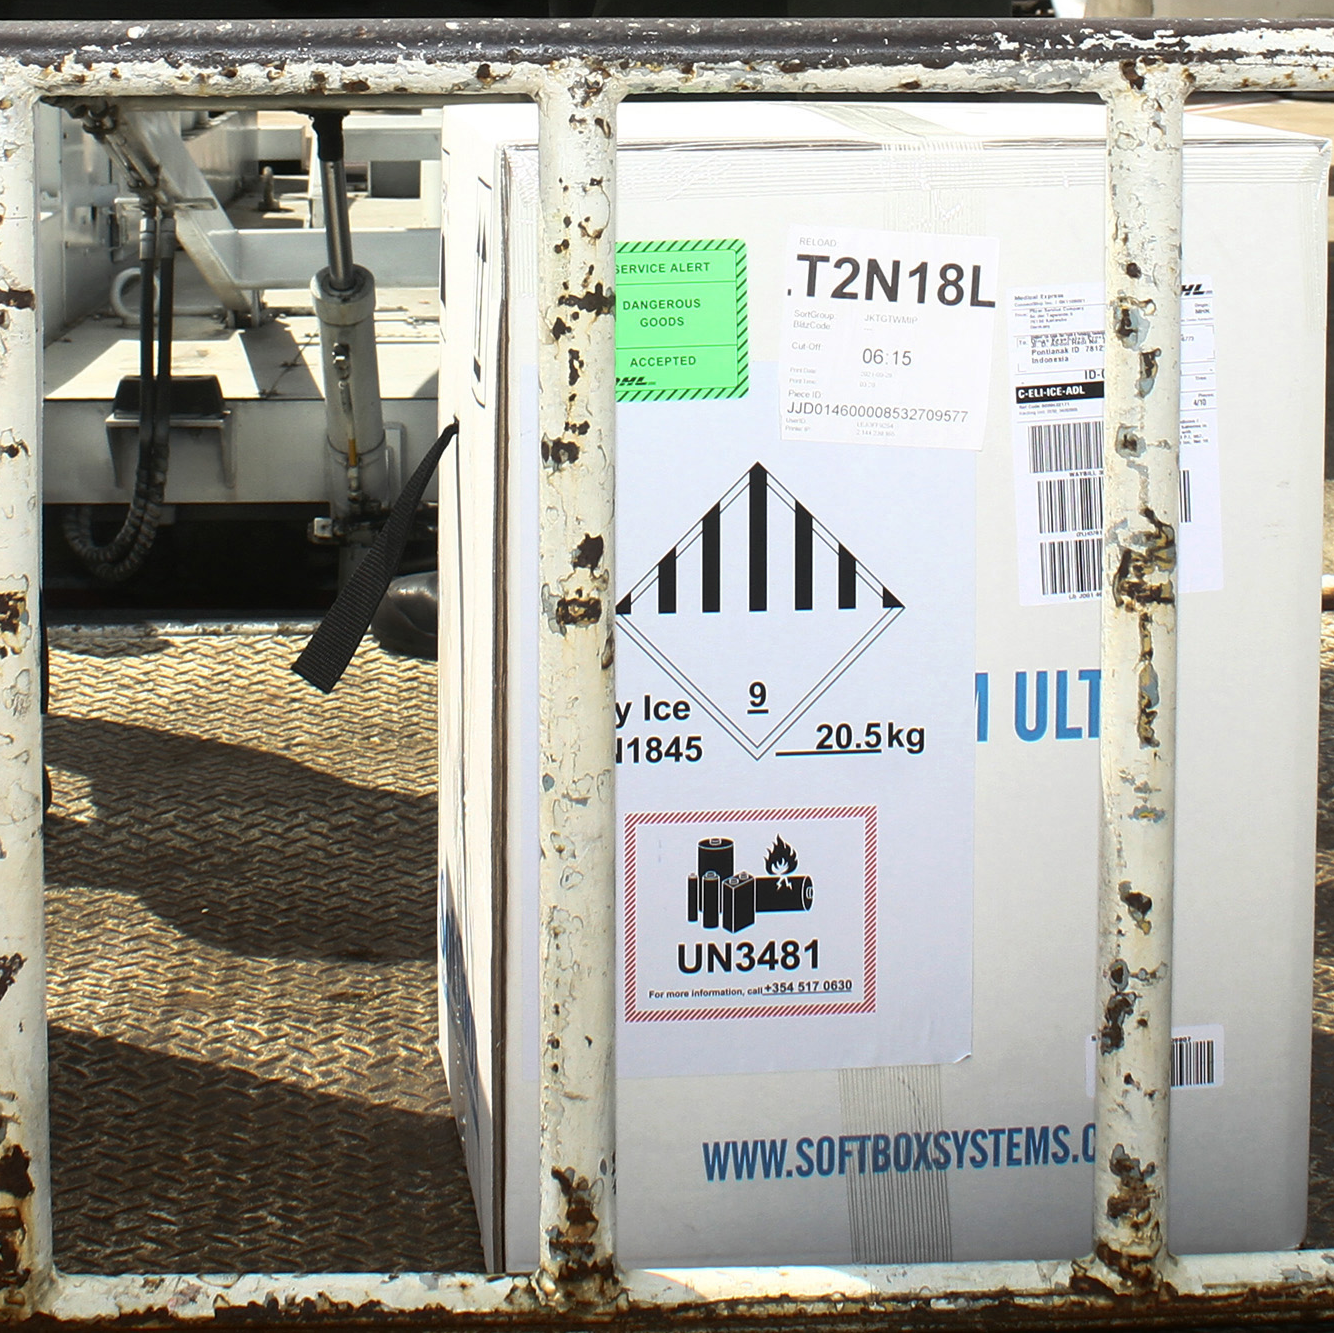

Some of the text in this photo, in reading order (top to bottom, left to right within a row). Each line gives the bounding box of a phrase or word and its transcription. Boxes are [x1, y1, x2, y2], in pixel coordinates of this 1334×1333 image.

[670, 262, 711, 273] ALERT
[622, 298, 701, 311] DANGEROUS
[639, 316, 685, 328] GOODS
[862, 348, 912, 366] 06:15
[1031, 347, 1069, 356] Pontianak
[1071, 346, 1080, 354] ID
[630, 356, 697, 367] ACCEPTED
[1031, 356, 1069, 364] Indonesia
[1017, 385, 1086, 399] C-ELI-ICE-ADL
[749, 681, 767, 707] 9
[643, 695, 691, 722] Ice
[1014, 669, 1102, 743] ULT
[677, 938, 819, 975] UN3481
[648, 990, 664, 999] For
[666, 989, 689, 999] more
[747, 986, 763, 996] call
[764, 982, 794, 993] +354
[797, 980, 820, 993] 517
[823, 979, 853, 991] 0630
[702, 1122, 1096, 1182] WWW.SOFTBOXSYSTEMS.C
